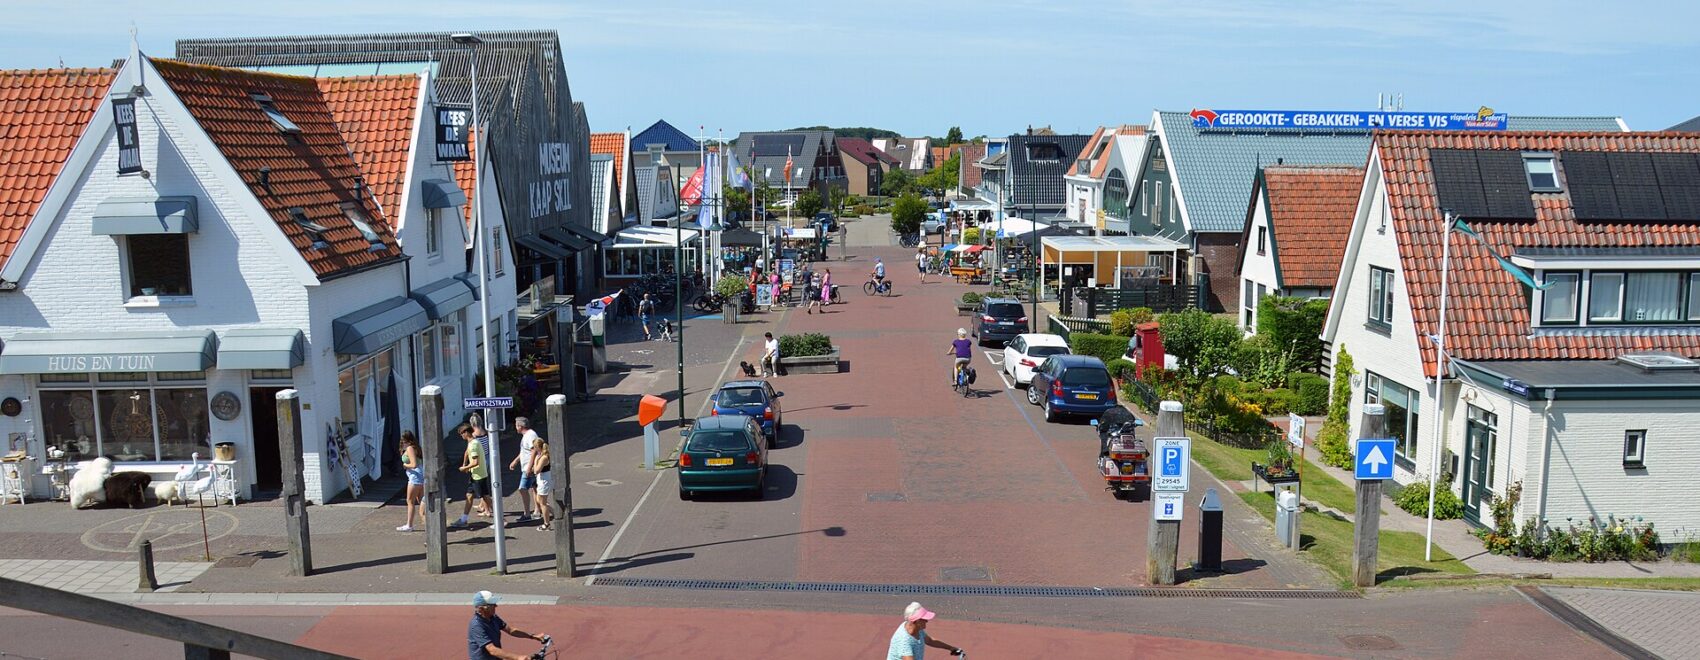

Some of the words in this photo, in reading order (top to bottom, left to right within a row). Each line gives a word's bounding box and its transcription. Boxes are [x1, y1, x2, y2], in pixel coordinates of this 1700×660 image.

[116, 104, 134, 124] KEES
[440, 110, 466, 126] KEES
[1219, 113, 1290, 125] GEROOKTE-
[1293, 114, 1364, 126] GEBAKKEN-
[1368, 114, 1384, 126] EN
[1388, 114, 1424, 127] VERSE
[1428, 115, 1448, 127] VIS
[122, 126, 133, 145] DE
[445, 126, 459, 141] DE
[120, 148, 141, 168] WAAL
[437, 143, 469, 158] WAAL
[539, 142, 571, 175] MUSEUM
[529, 181, 552, 218] KAAP
[553, 178, 572, 212] SKIL
[48, 356, 87, 370] HUIS
[91, 356, 113, 370] EN
[117, 355, 155, 369] TUIN
[1166, 449, 1177, 464] P
